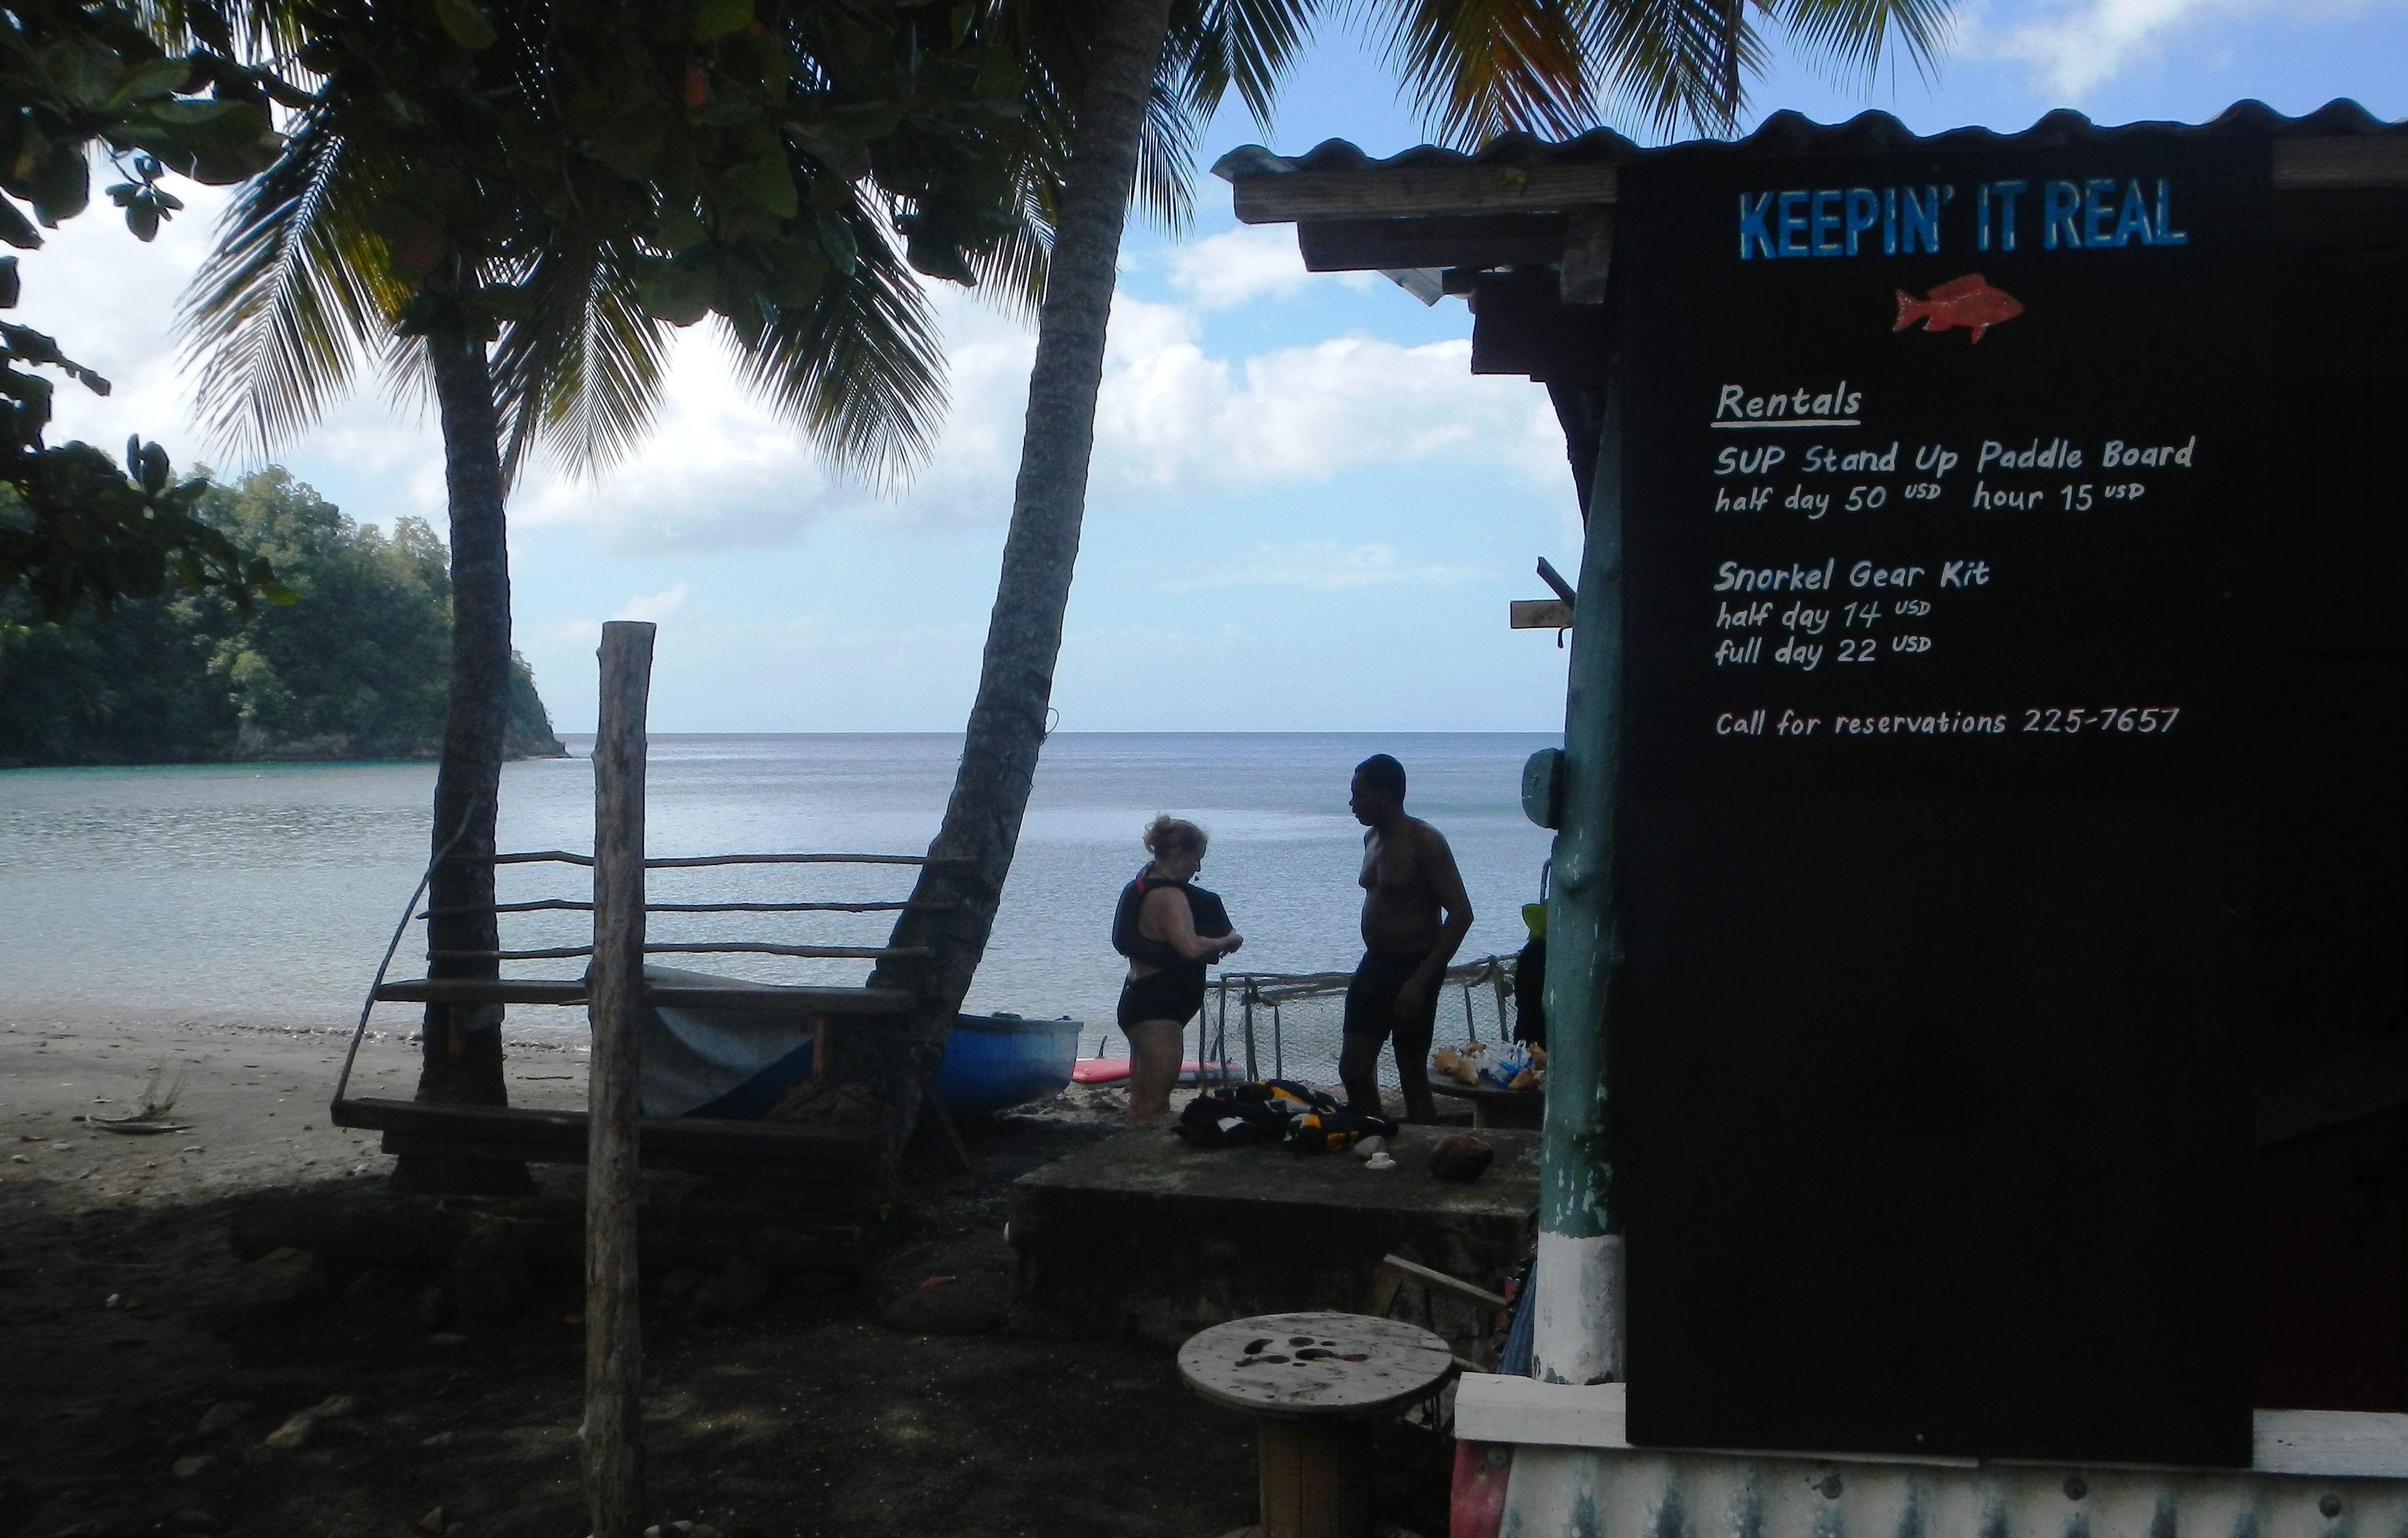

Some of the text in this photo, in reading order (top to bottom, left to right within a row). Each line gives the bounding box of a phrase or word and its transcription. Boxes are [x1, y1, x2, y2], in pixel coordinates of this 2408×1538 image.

[1740, 179, 2187, 260] KEEPIN' IT REAL
[1716, 380, 1862, 419] Rentals
[1714, 435, 2196, 476] SUP Stand Up Paddle Board
[1714, 480, 2145, 520] half day 50 USD hour 15 USD
[1713, 557, 1990, 592] Snorkel Gear Kit
[1716, 599, 1931, 635] half day 14 USD
[1714, 635, 1932, 671] full day 22 USD
[1716, 707, 2180, 736] Call for reservations 225-7657
